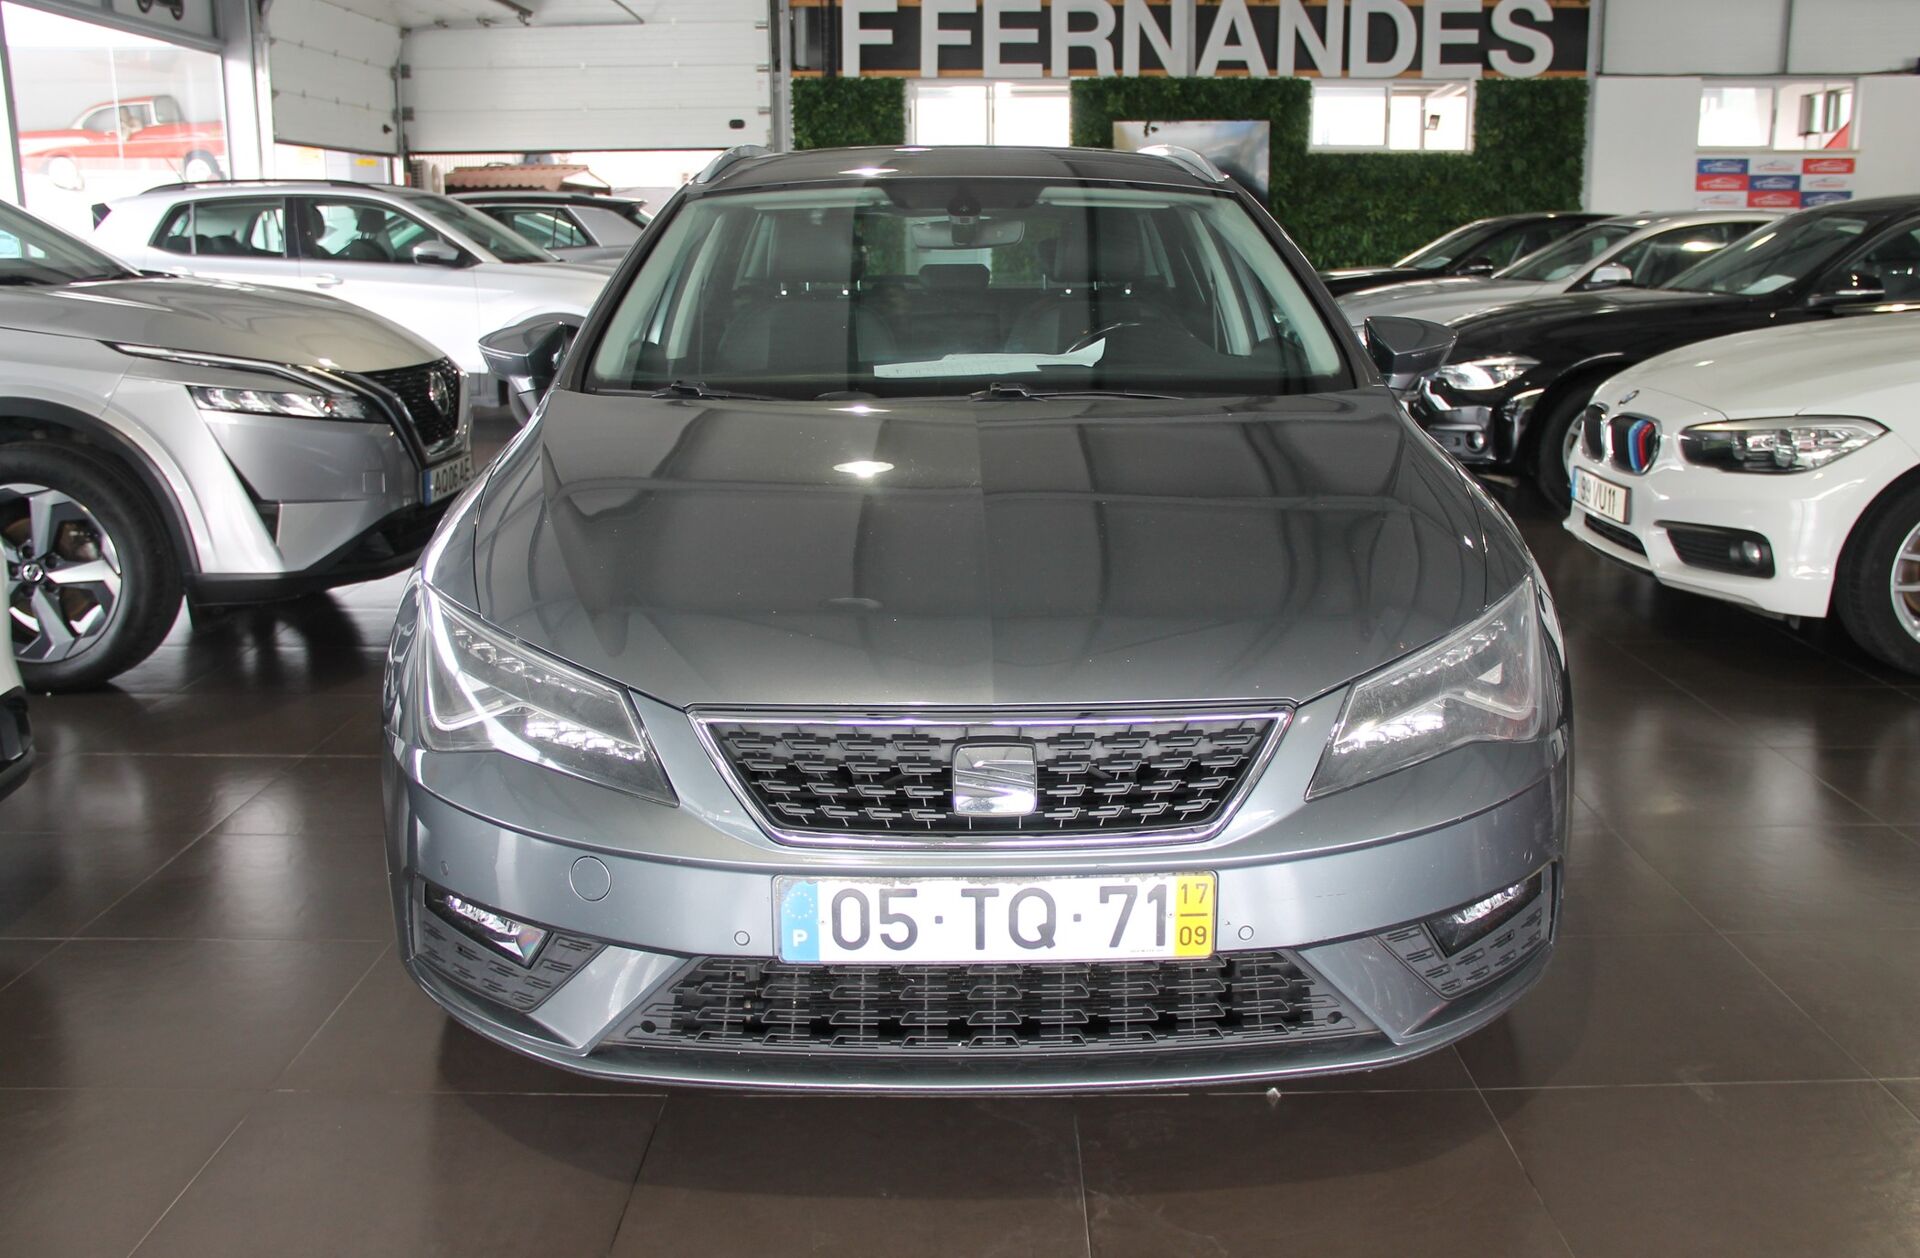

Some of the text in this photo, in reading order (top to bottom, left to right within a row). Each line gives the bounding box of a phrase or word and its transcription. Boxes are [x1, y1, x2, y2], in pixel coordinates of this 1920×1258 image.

[842, 0, 1555, 77] F FERNANDES
[1181, 883, 1208, 905] 17
[792, 929, 808, 945] P
[1178, 926, 1208, 947] 09
